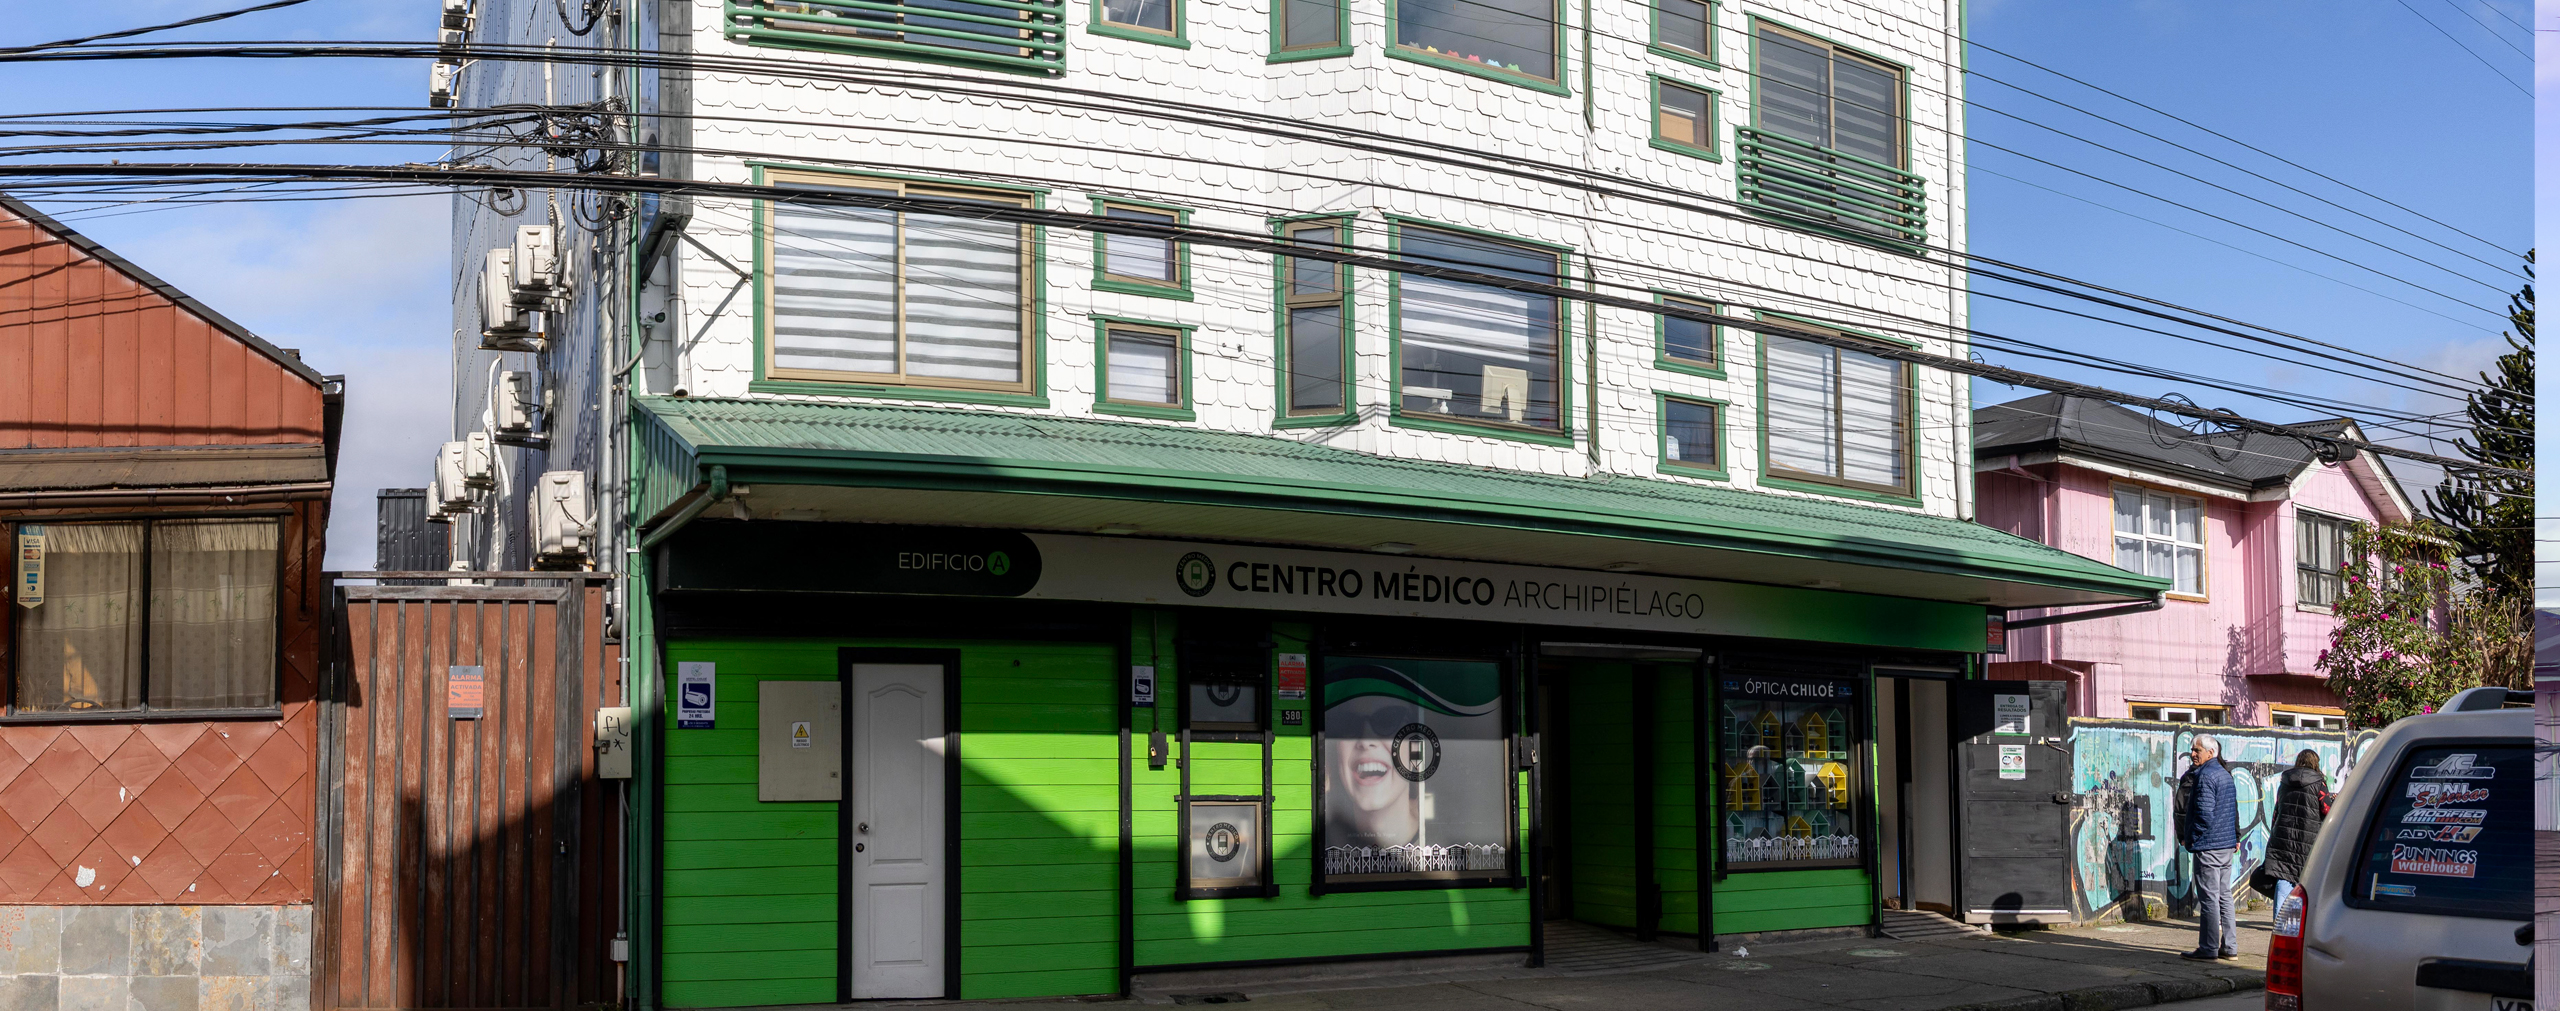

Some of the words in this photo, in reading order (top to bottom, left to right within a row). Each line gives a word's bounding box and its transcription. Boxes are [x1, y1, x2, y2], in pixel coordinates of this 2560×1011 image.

[898, 552, 984, 572] EDIFICIO
[992, 554, 1006, 572] A
[1227, 561, 1363, 598] CENTRO
[1373, 564, 1495, 606] MÉDICO
[1503, 580, 1704, 619] ARCHIPIÉLAGO
[1745, 678, 1788, 695] ÓPTICA
[1790, 682, 1834, 697] CHILOÉ
[1285, 711, 1301, 720] 580
[1393, 725, 1416, 748] CENTRO
[2436, 754, 2477, 769] AC
[2406, 783, 2470, 797] KONI
[2413, 789, 2489, 808] Supercar
[1207, 823, 1223, 839] CENTRO
[2397, 828, 2470, 842] ADVAN
[2393, 844, 2476, 864] BUNNINGS
[2398, 859, 2468, 874] warehouse
